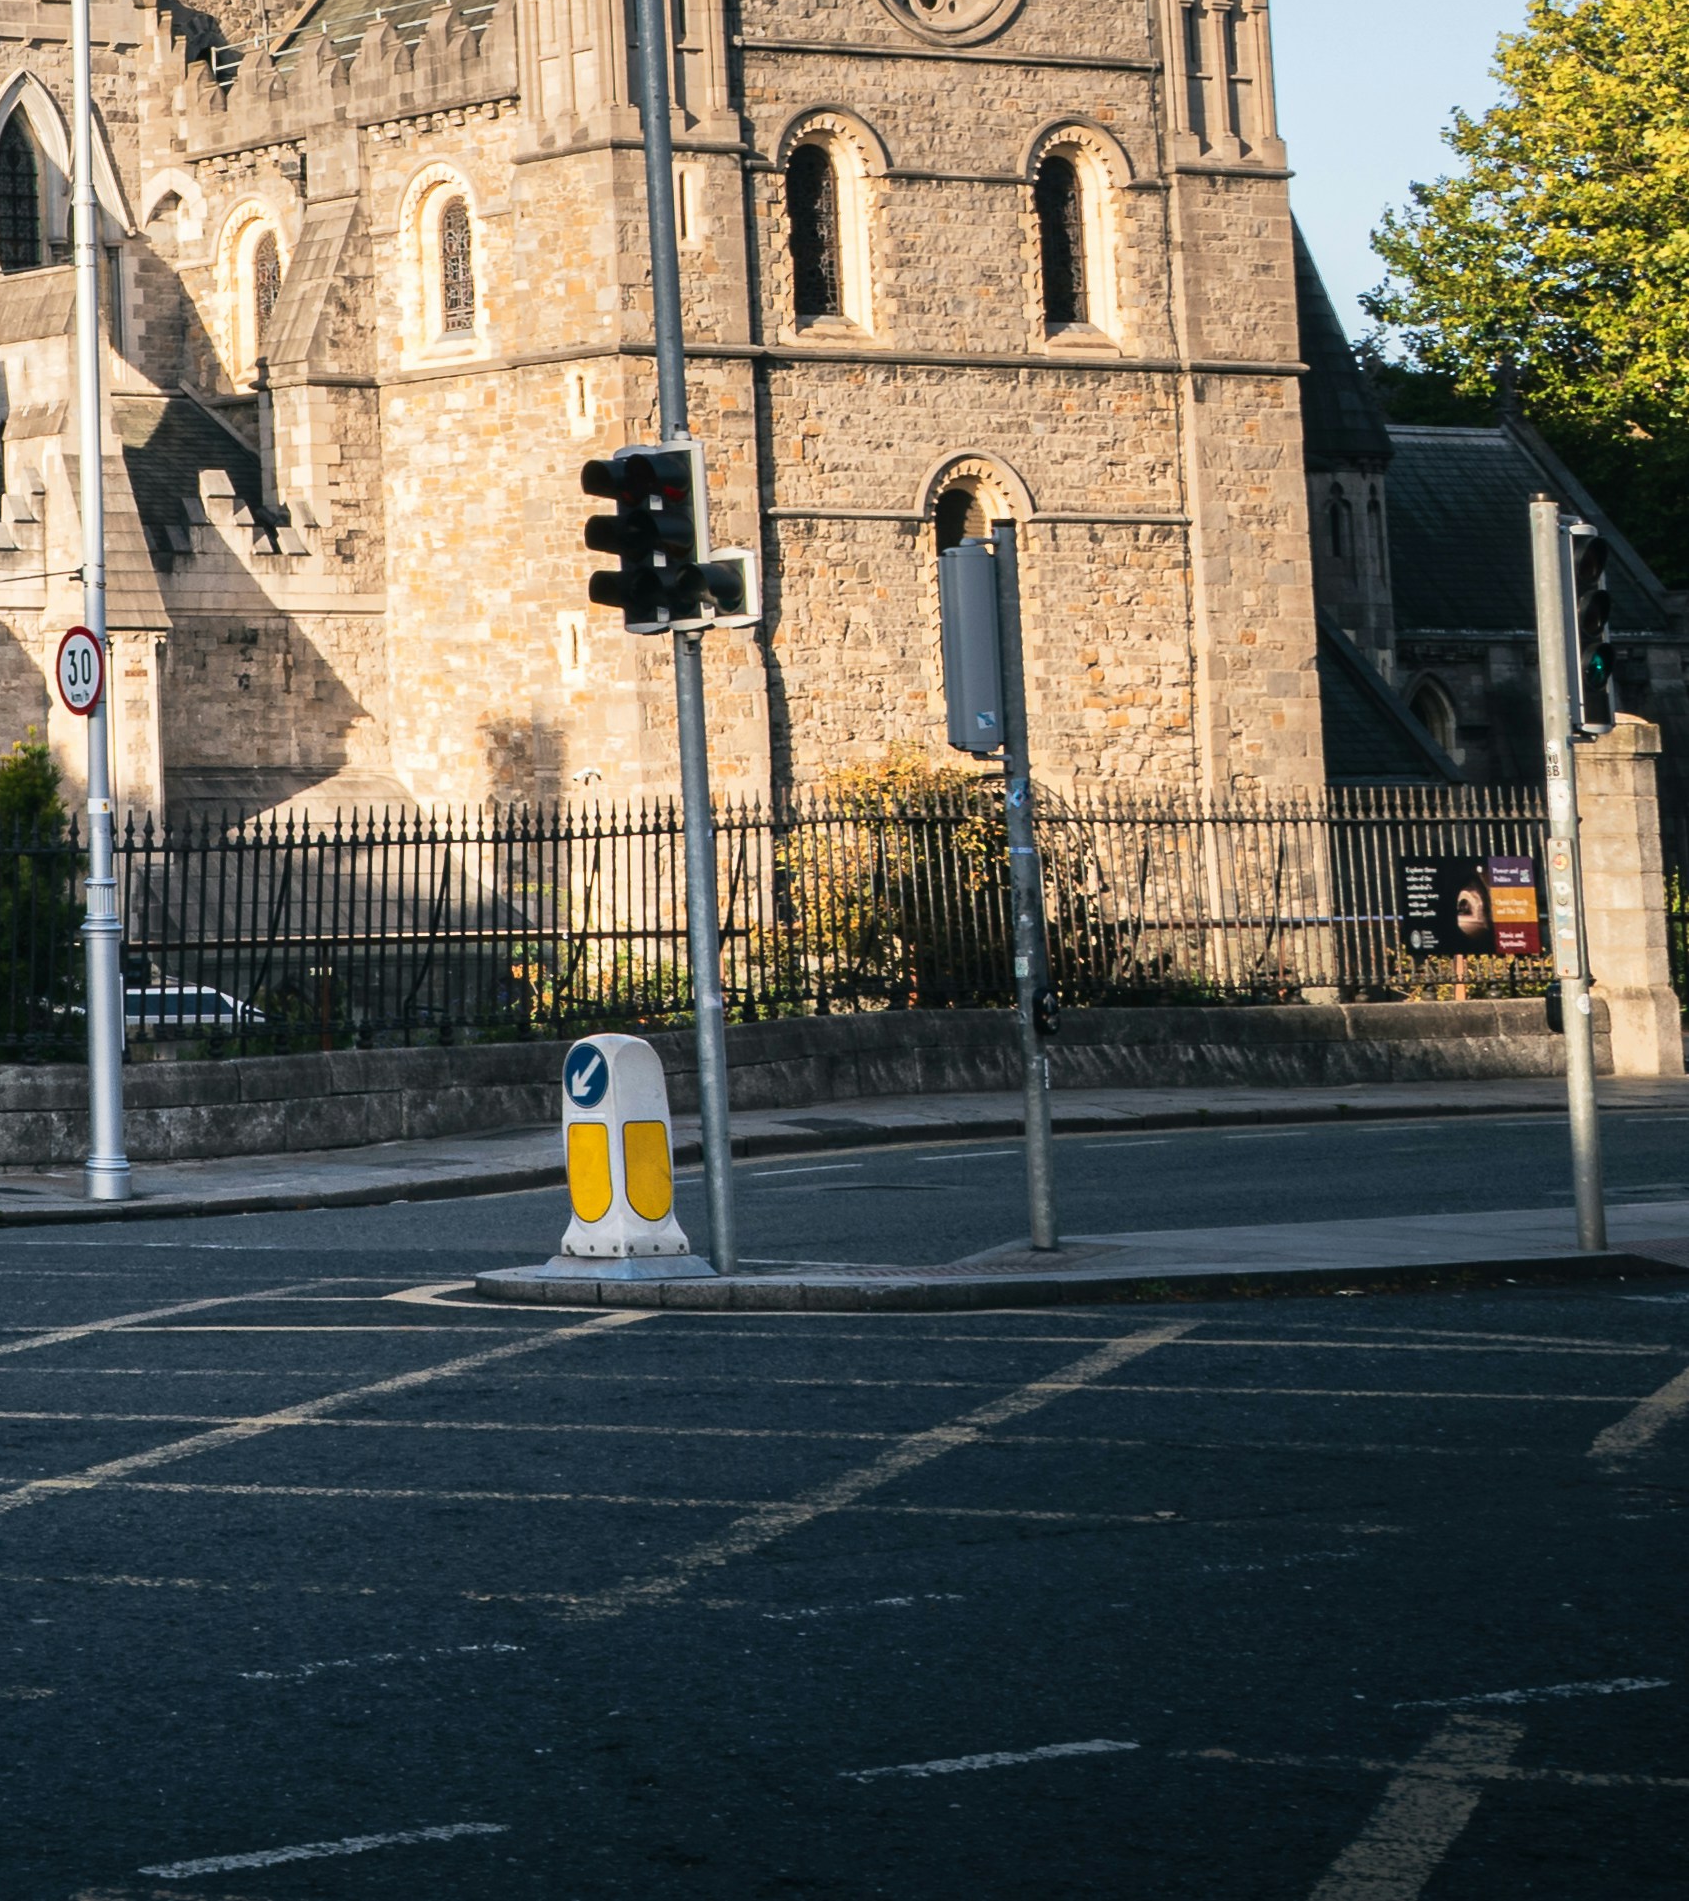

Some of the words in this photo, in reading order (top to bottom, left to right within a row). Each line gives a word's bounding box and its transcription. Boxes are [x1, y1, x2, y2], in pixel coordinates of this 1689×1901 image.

[67, 648, 91, 686] 30
[71, 689, 90, 703] km/h
[1509, 866, 1519, 874] and
[1514, 931, 1524, 939] and
